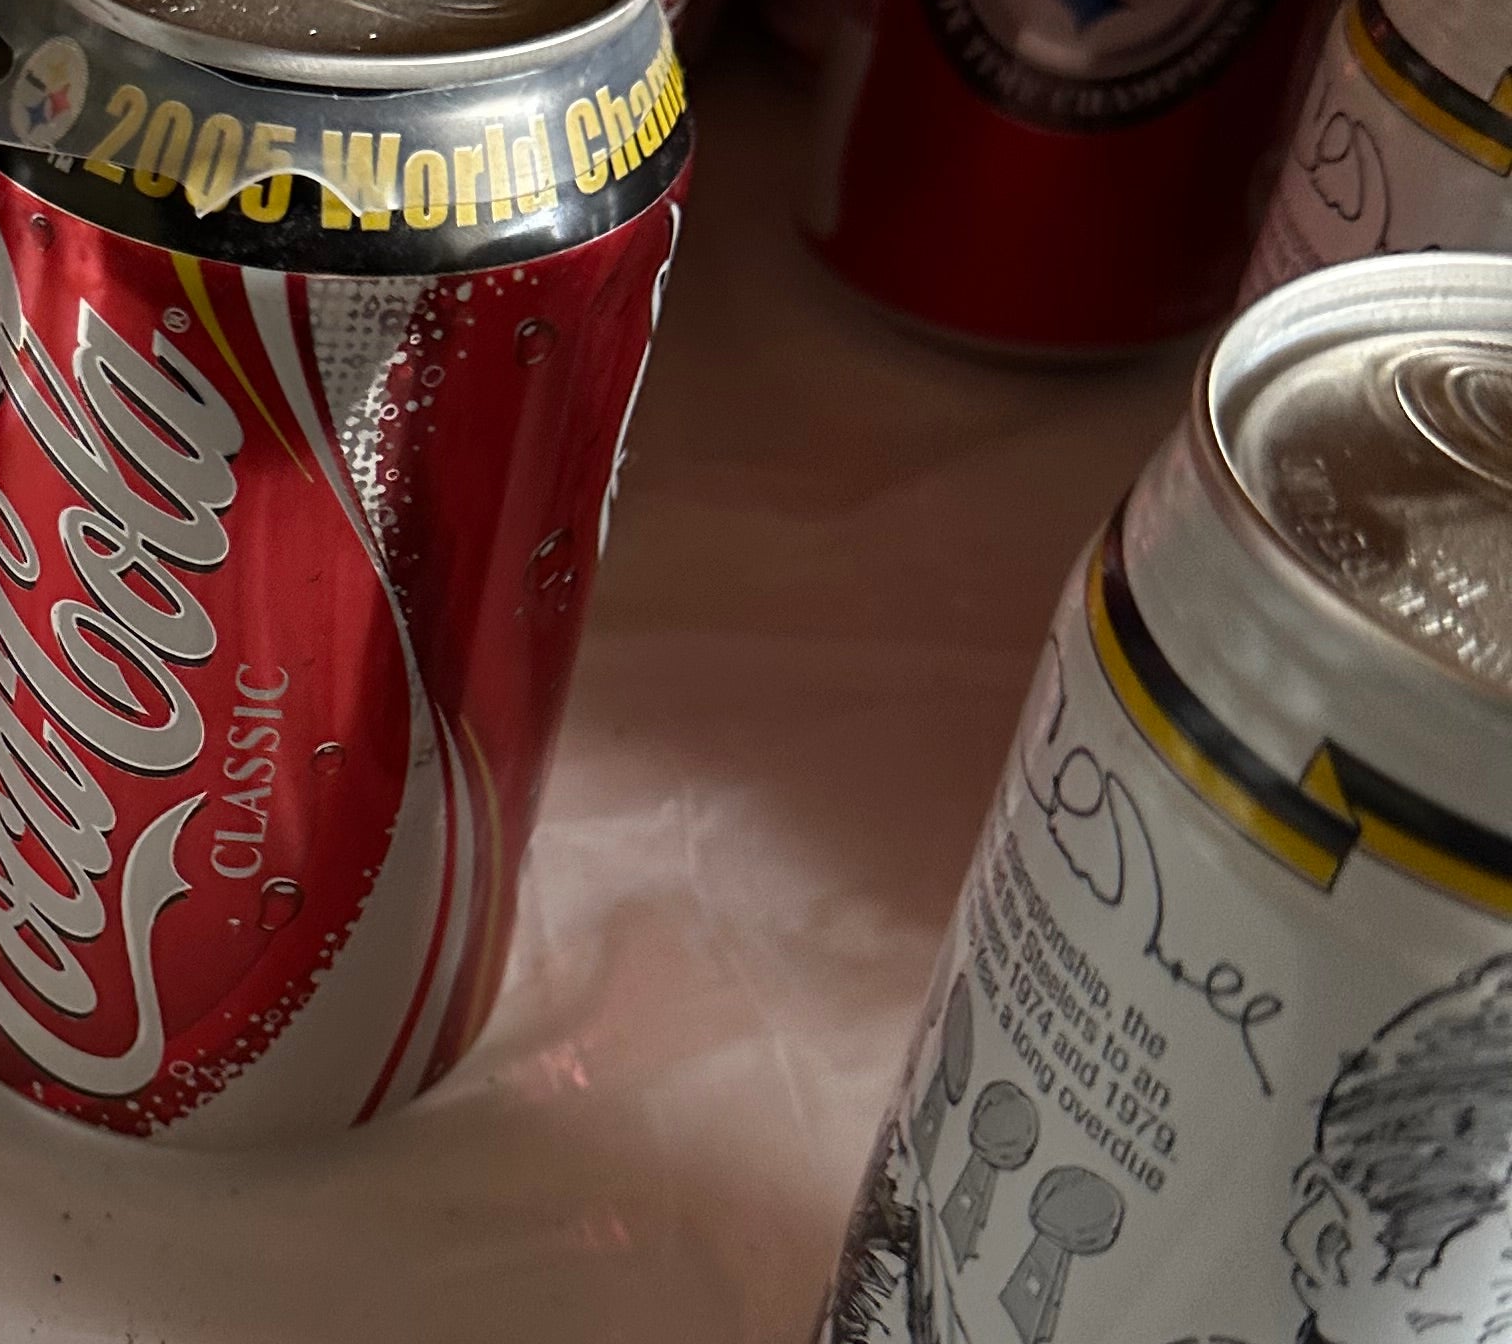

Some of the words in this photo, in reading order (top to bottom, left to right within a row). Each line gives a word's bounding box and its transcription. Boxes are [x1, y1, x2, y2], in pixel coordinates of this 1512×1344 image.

[82, 84, 296, 224] 2005
[320, 111, 550, 233] World
[209, 662, 289, 880] CLASSIC
[1010, 960, 1057, 1036] 1974
[1051, 1030, 1101, 1088] and
[1021, 928, 1099, 1044] Steelers
[1101, 1034, 1130, 1074] to
[1131, 1065, 1172, 1111] an
[1120, 1003, 1169, 1059] the
[1011, 1017, 1057, 1094] long
[1057, 1086, 1169, 1193] overdue
